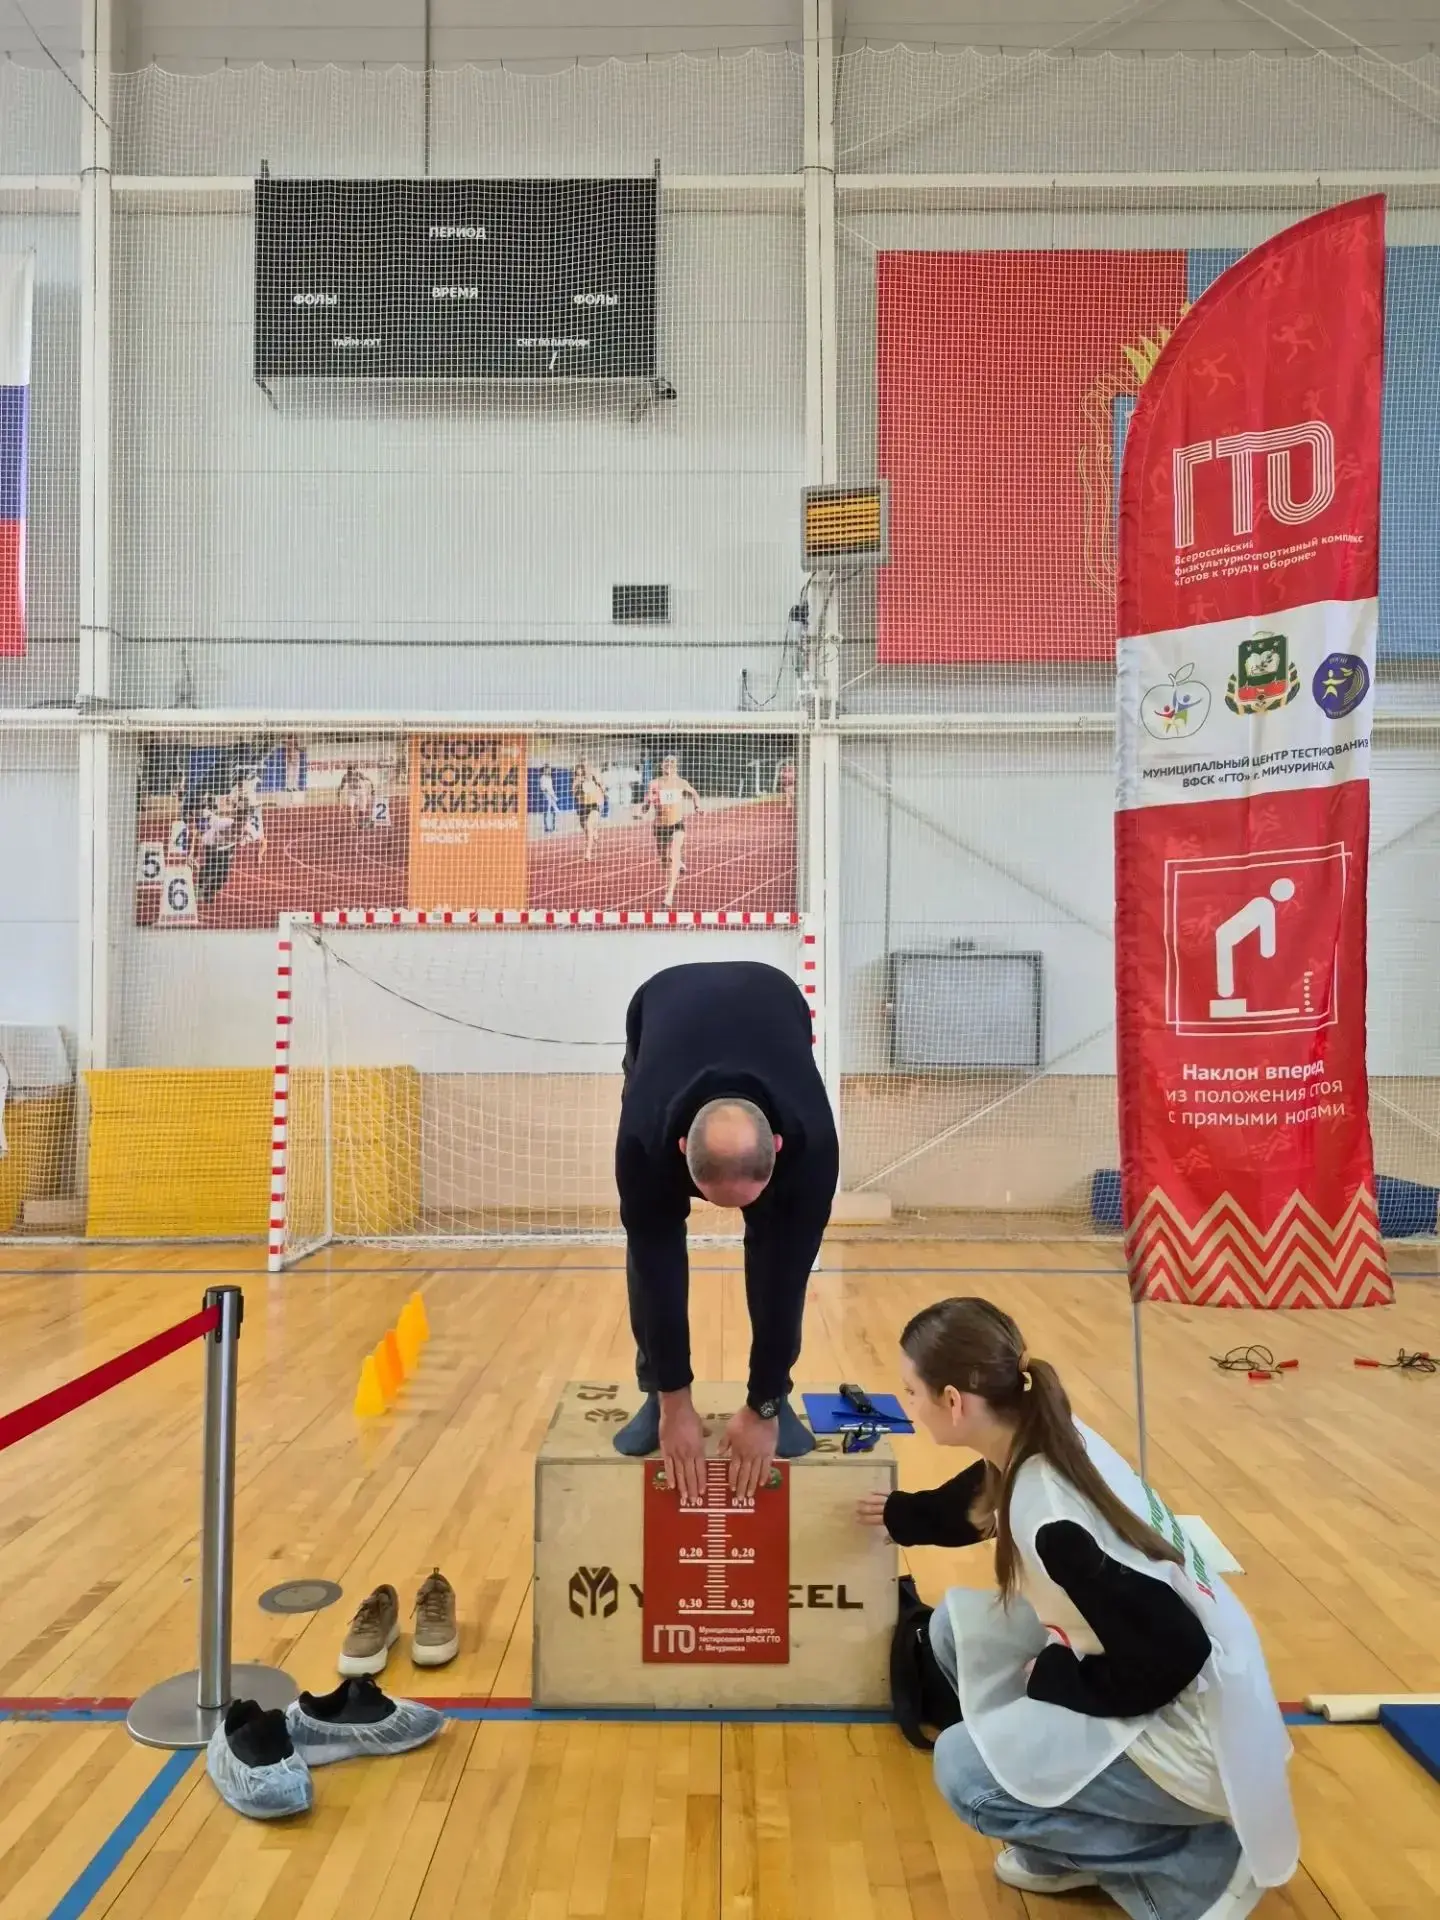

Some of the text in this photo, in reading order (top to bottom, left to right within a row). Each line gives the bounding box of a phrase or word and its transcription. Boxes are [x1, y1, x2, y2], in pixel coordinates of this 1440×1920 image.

[429, 227, 487, 239] ПЕРИОД
[293, 293, 338, 304] ФОЛЫ
[432, 287, 478, 299] ВРЕМЯ
[573, 294, 618, 304] ФОЛЫ
[1173, 420, 1335, 549] ГТО
[1321, 534, 1364, 545] компкс
[1175, 540, 1254, 565] Всероссийский
[1174, 572, 1209, 587] «Готов
[1212, 570, 1218, 578] к
[1262, 551, 1316, 571] обороне»
[421, 740, 502, 760] СПОРТ
[1142, 756, 1250, 779] МУНИЦИПАЛЬНЫЙ
[1252, 750, 1288, 768] ЦЕНТР
[1182, 775, 1215, 788] ВФСК
[1218, 773, 1250, 783] «ГТО»
[1262, 760, 1335, 778] МИЧУРИНСКА
[421, 765, 518, 787] НОРМА
[375, 803, 387, 820] 2
[421, 791, 518, 813] ЖИЗНИ
[175, 827, 188, 851] 4
[143, 851, 160, 879] 5
[168, 878, 189, 911] 6
[1183, 1059, 1324, 1081] Наклон вперед
[1167, 1080, 1343, 1103] из положения стоя
[1168, 1103, 1345, 1129] с прямыми ногами
[679, 1547, 703, 1558] 0,20
[731, 1547, 755, 1558] 0,20
[678, 1598, 703, 1609] 0,30
[731, 1598, 755, 1609] 0,30
[653, 1624, 695, 1653] ГТО
